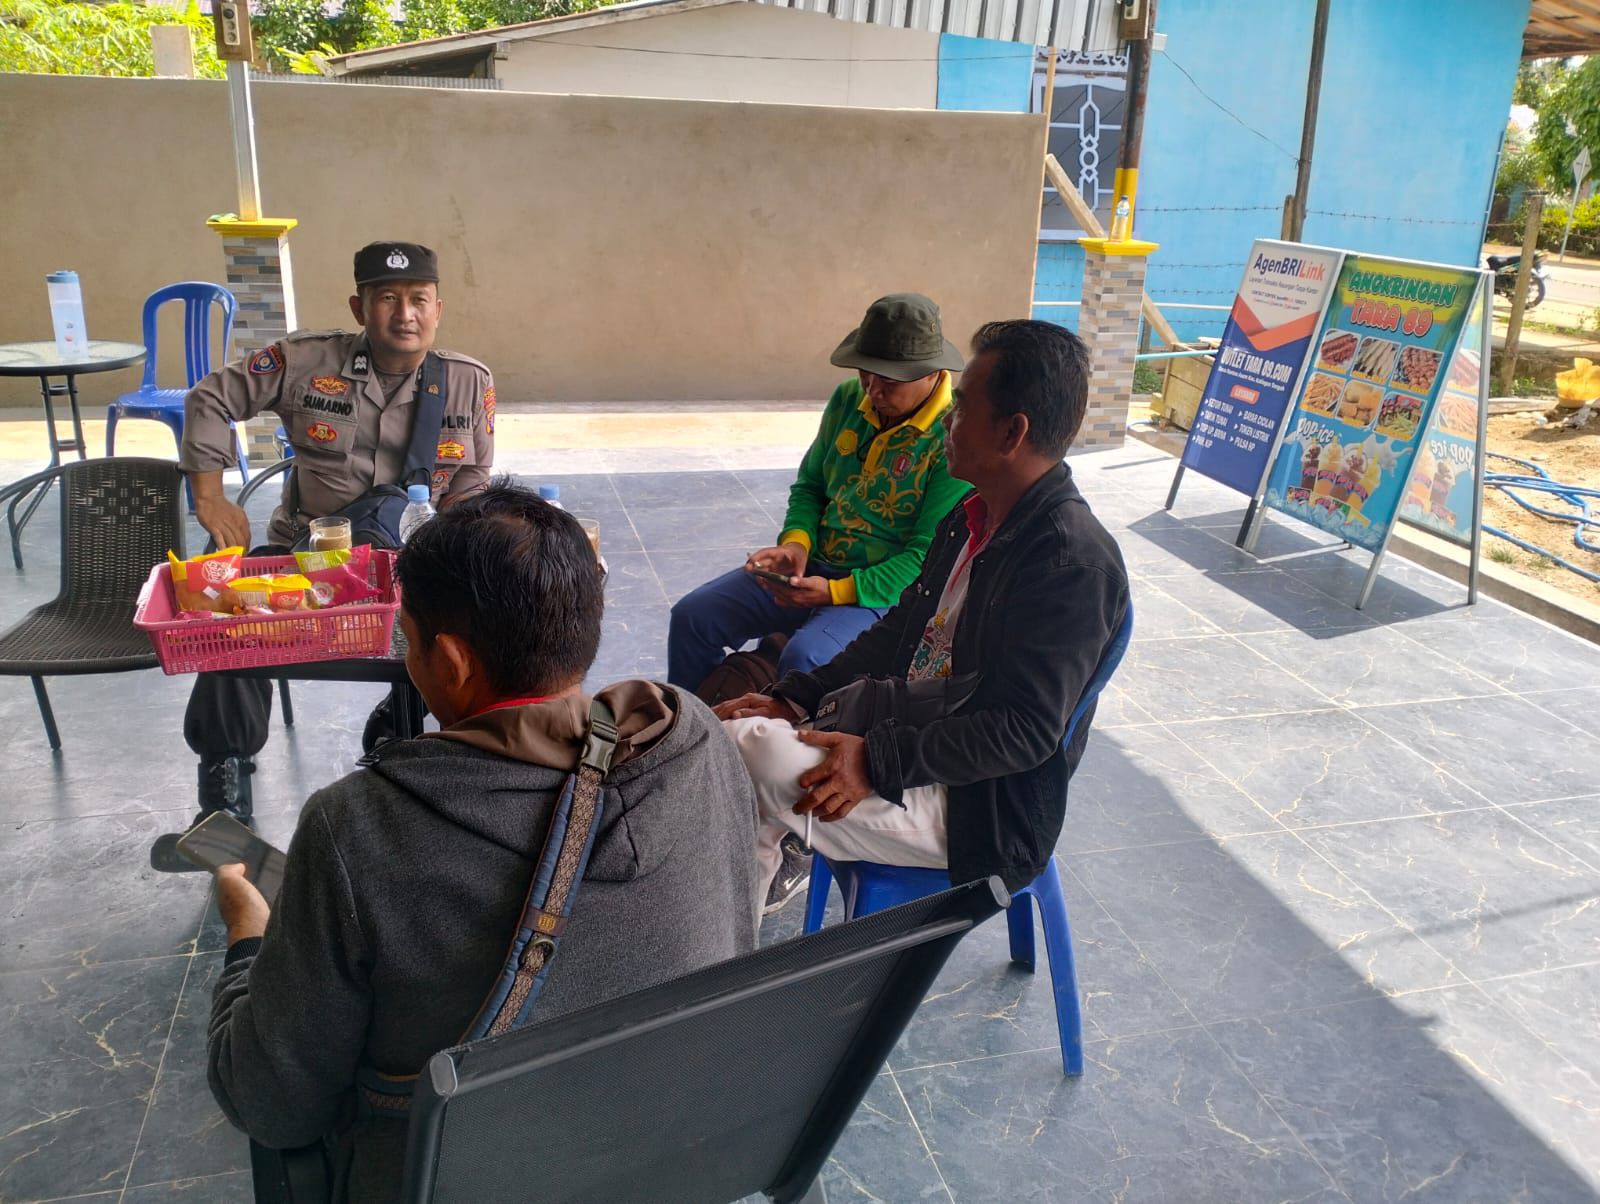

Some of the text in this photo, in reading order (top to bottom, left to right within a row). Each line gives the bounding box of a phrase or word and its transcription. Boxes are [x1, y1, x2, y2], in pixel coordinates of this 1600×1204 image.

[1349, 271, 1457, 307] ANGKRINGAN
[1351, 298, 1434, 337] TARA 89
[1221, 347, 1246, 369] OUTLET
[302, 394, 353, 416] SUMARNO
[440, 415, 470, 429] LRI
